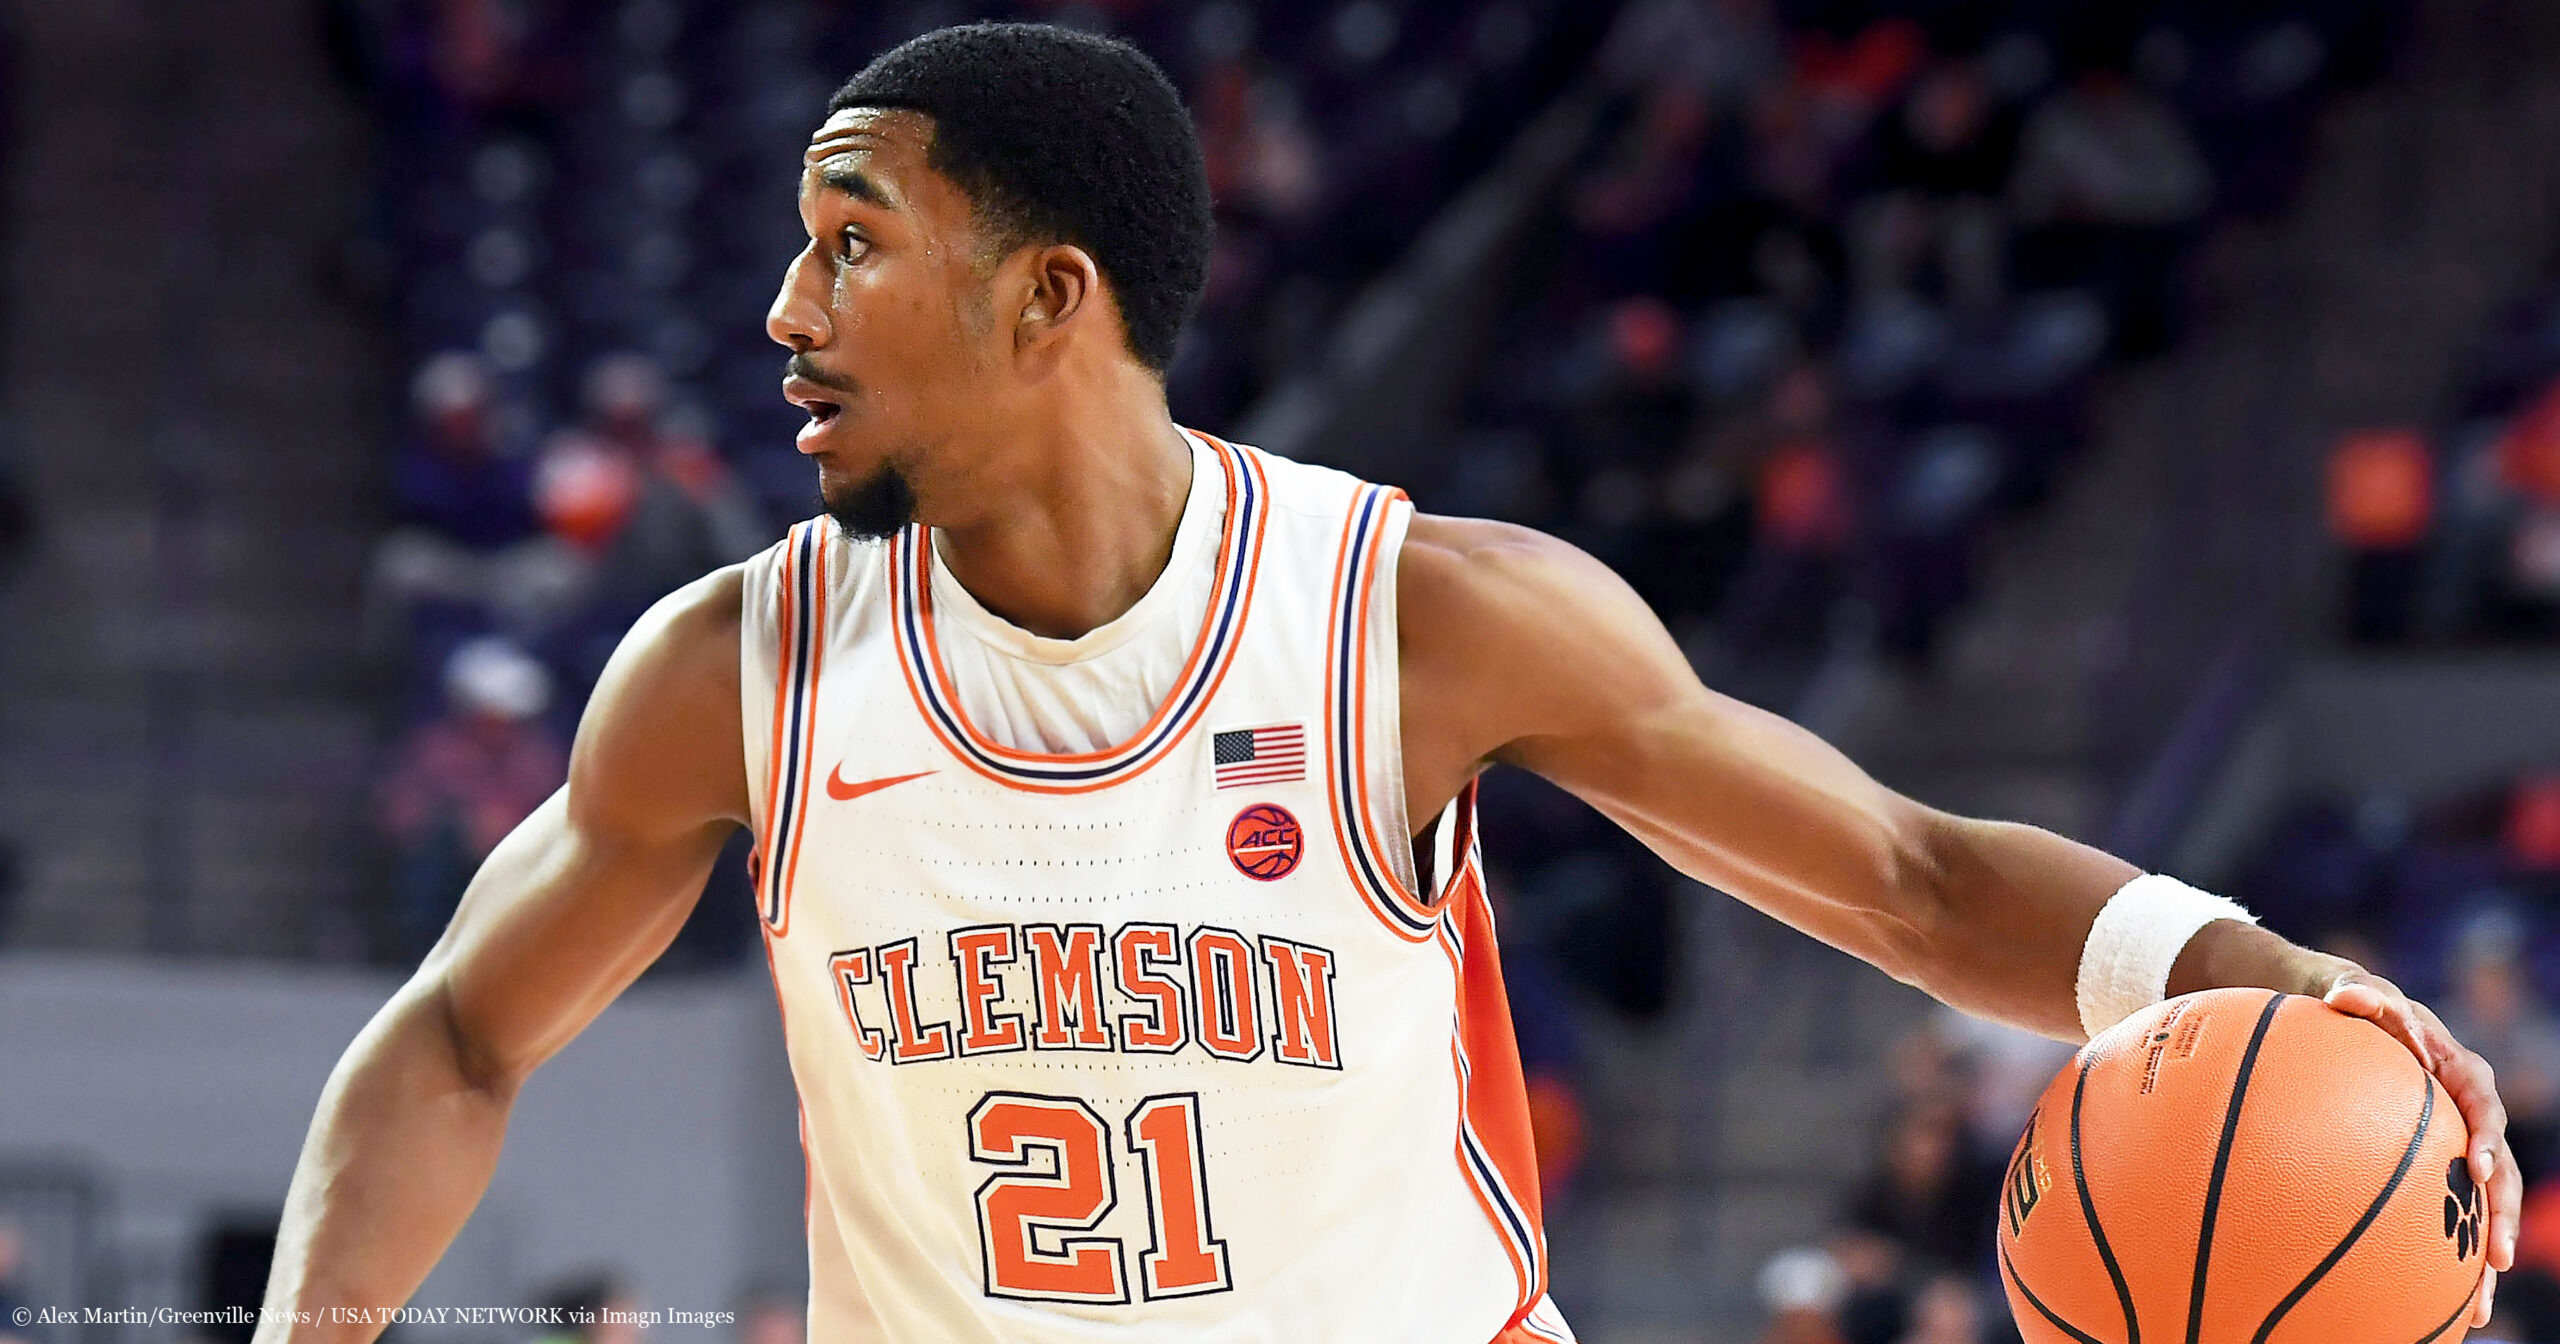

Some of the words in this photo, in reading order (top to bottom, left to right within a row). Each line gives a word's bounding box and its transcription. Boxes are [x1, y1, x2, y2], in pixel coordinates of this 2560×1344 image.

[1240, 826, 1297, 848] ACC
[827, 922, 1344, 1071] CLEMSON
[966, 1090, 1234, 1306] 21
